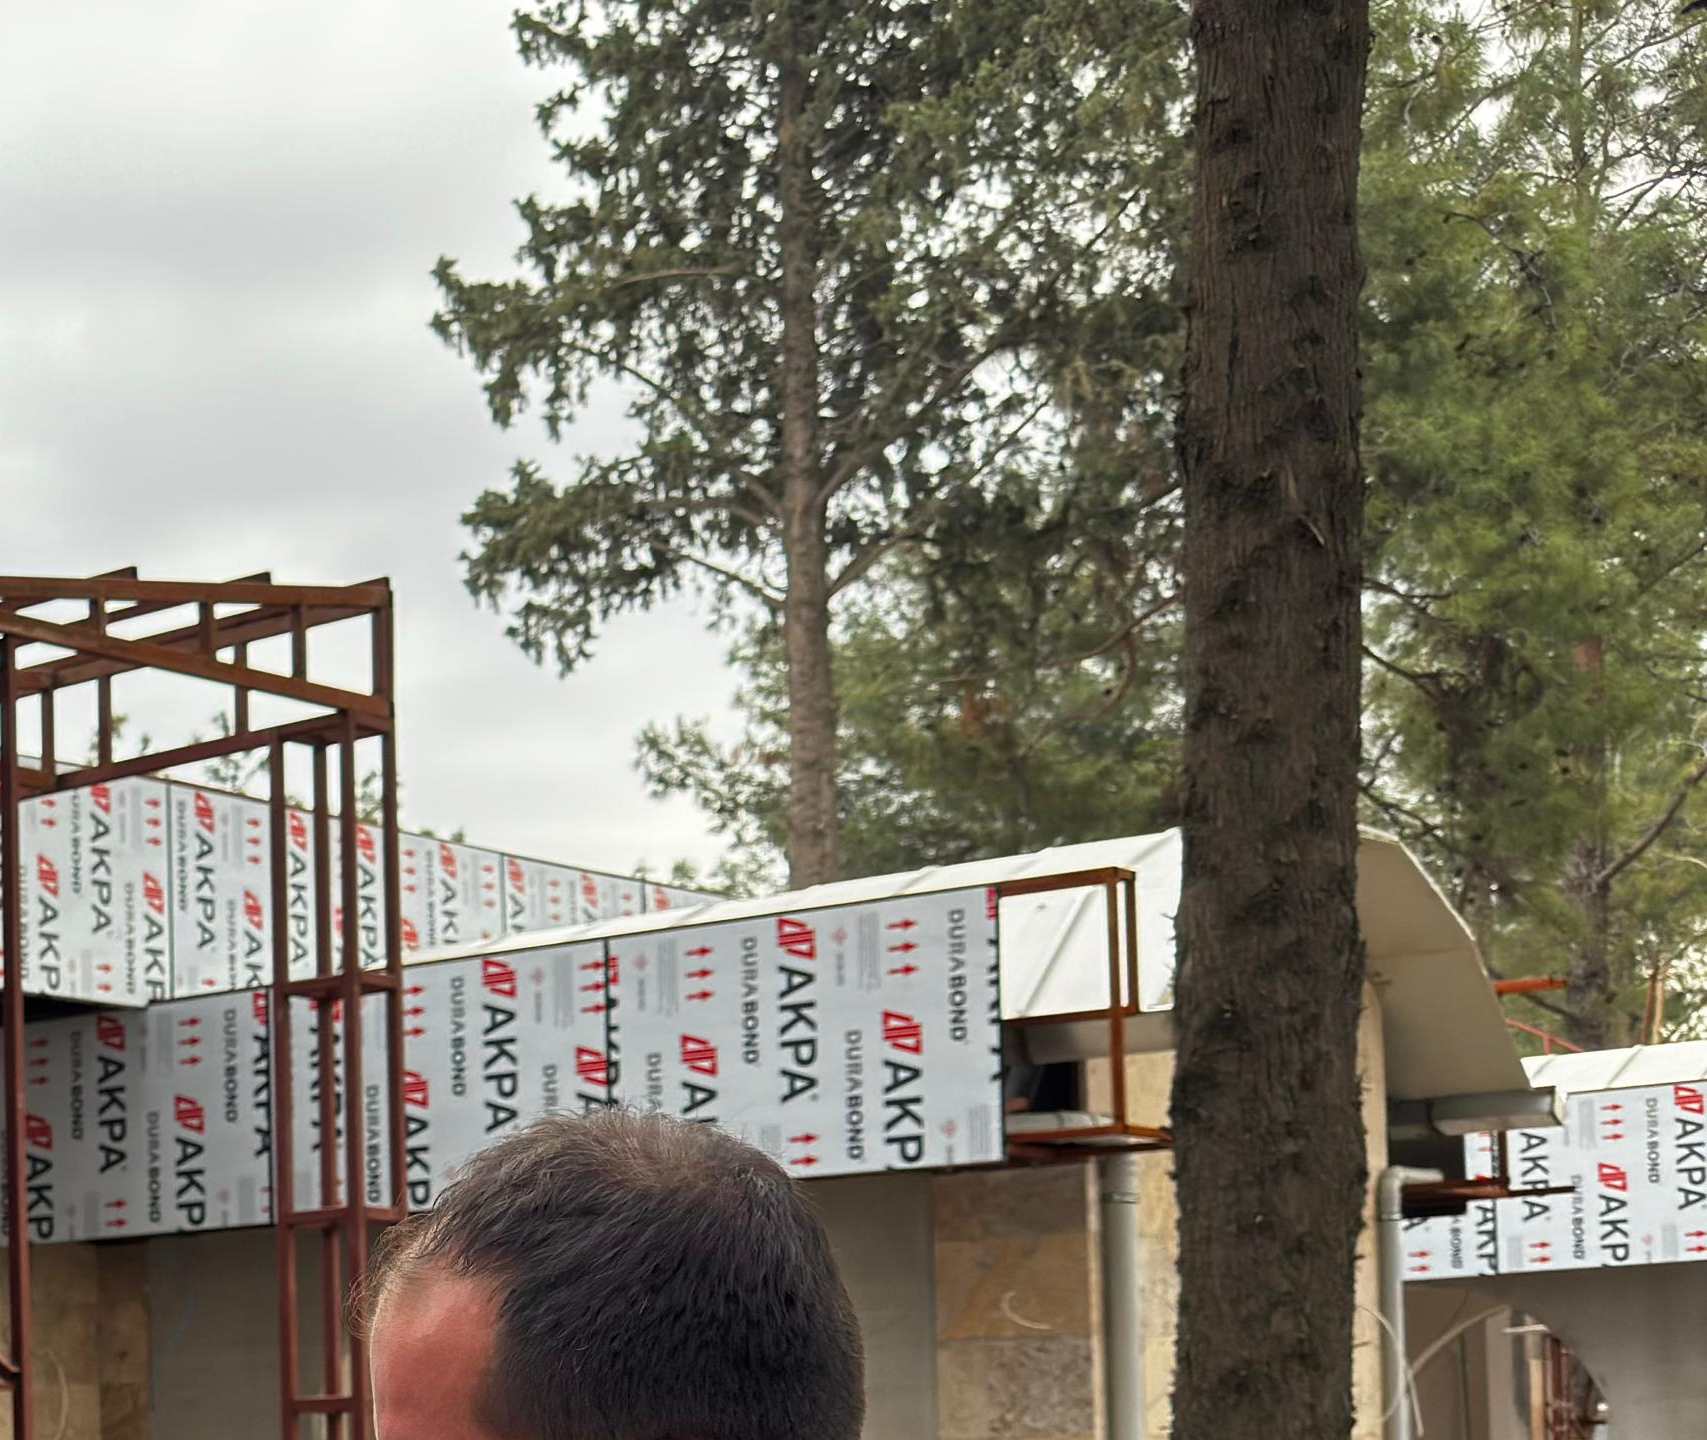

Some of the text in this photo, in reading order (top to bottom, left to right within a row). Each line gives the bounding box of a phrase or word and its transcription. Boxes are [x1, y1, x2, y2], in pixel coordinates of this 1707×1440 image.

[90, 812, 112, 935] AKPA
[195, 832, 217, 950] AKPA
[290, 850, 309, 964] AKPA
[38, 897, 61, 994] AKP
[143, 914, 166, 1000] AKP
[244, 929, 263, 989] AK
[740, 936, 760, 1064] DURABOND
[948, 908, 968, 1042] DURABOND
[71, 1031, 84, 1141] DURABOND
[223, 1008, 238, 1123] DURABOND
[450, 976, 467, 1097] DURABOND
[483, 1004, 518, 1133] AKPA
[779, 966, 819, 1103] AKPA
[97, 1056, 128, 1174] AKPA
[367, 1085, 382, 1204] DURABOND
[844, 1029, 866, 1161] DURABOND
[883, 1060, 925, 1170] AKP
[1646, 1097, 1661, 1184] DURABOND
[27, 1153, 55, 1239] AKP
[148, 1110, 161, 1224] DURABOND
[175, 1137, 207, 1228] AKP
[406, 1116, 430, 1206] AKP
[1674, 1117, 1706, 1210] AKPA
[1475, 1204, 1498, 1276] AKP
[1570, 1175, 1586, 1260] DURABOND
[1599, 1194, 1630, 1267] AKP
